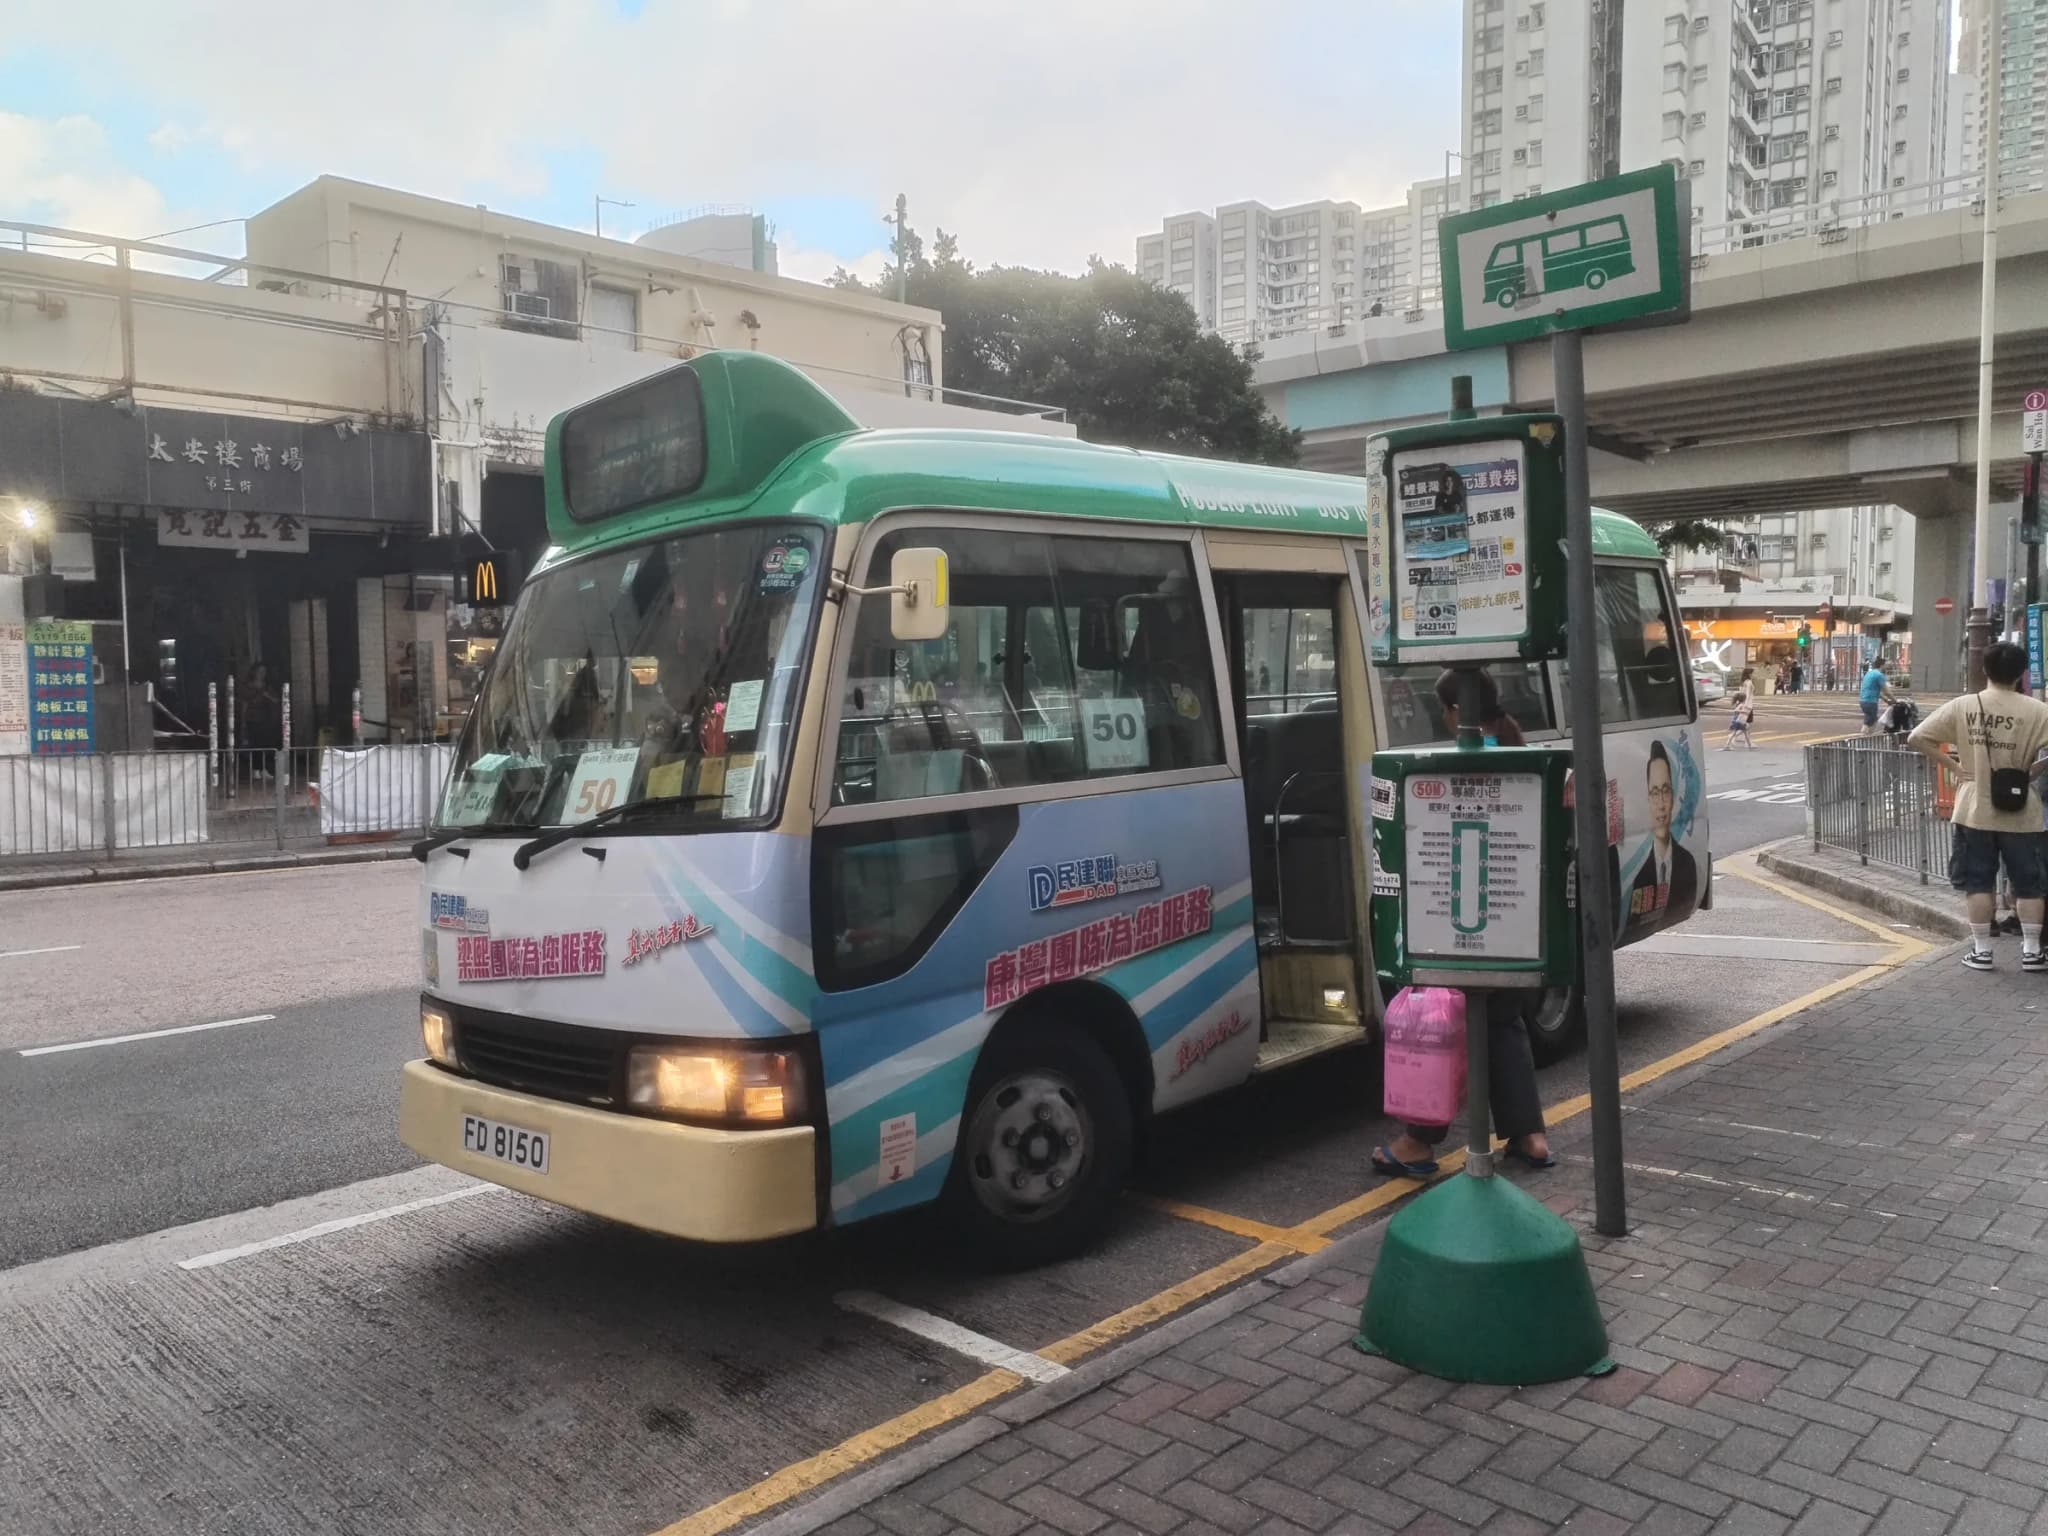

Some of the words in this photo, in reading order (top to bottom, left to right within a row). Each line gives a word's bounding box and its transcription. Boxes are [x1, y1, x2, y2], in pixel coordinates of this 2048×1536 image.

[2034, 413, 2043, 426] Ho
[2025, 425, 2034, 439] Sai
[2034, 428, 2043, 448] Wan
[1092, 713, 1137, 741] 50
[575, 778, 617, 815] 50
[1417, 782, 1441, 797] 50M
[1451, 787, 1500, 799] 專線小巴
[1086, 884, 1117, 899] DAB
[465, 1117, 487, 1151] FD
[495, 1125, 544, 1168] 8150
